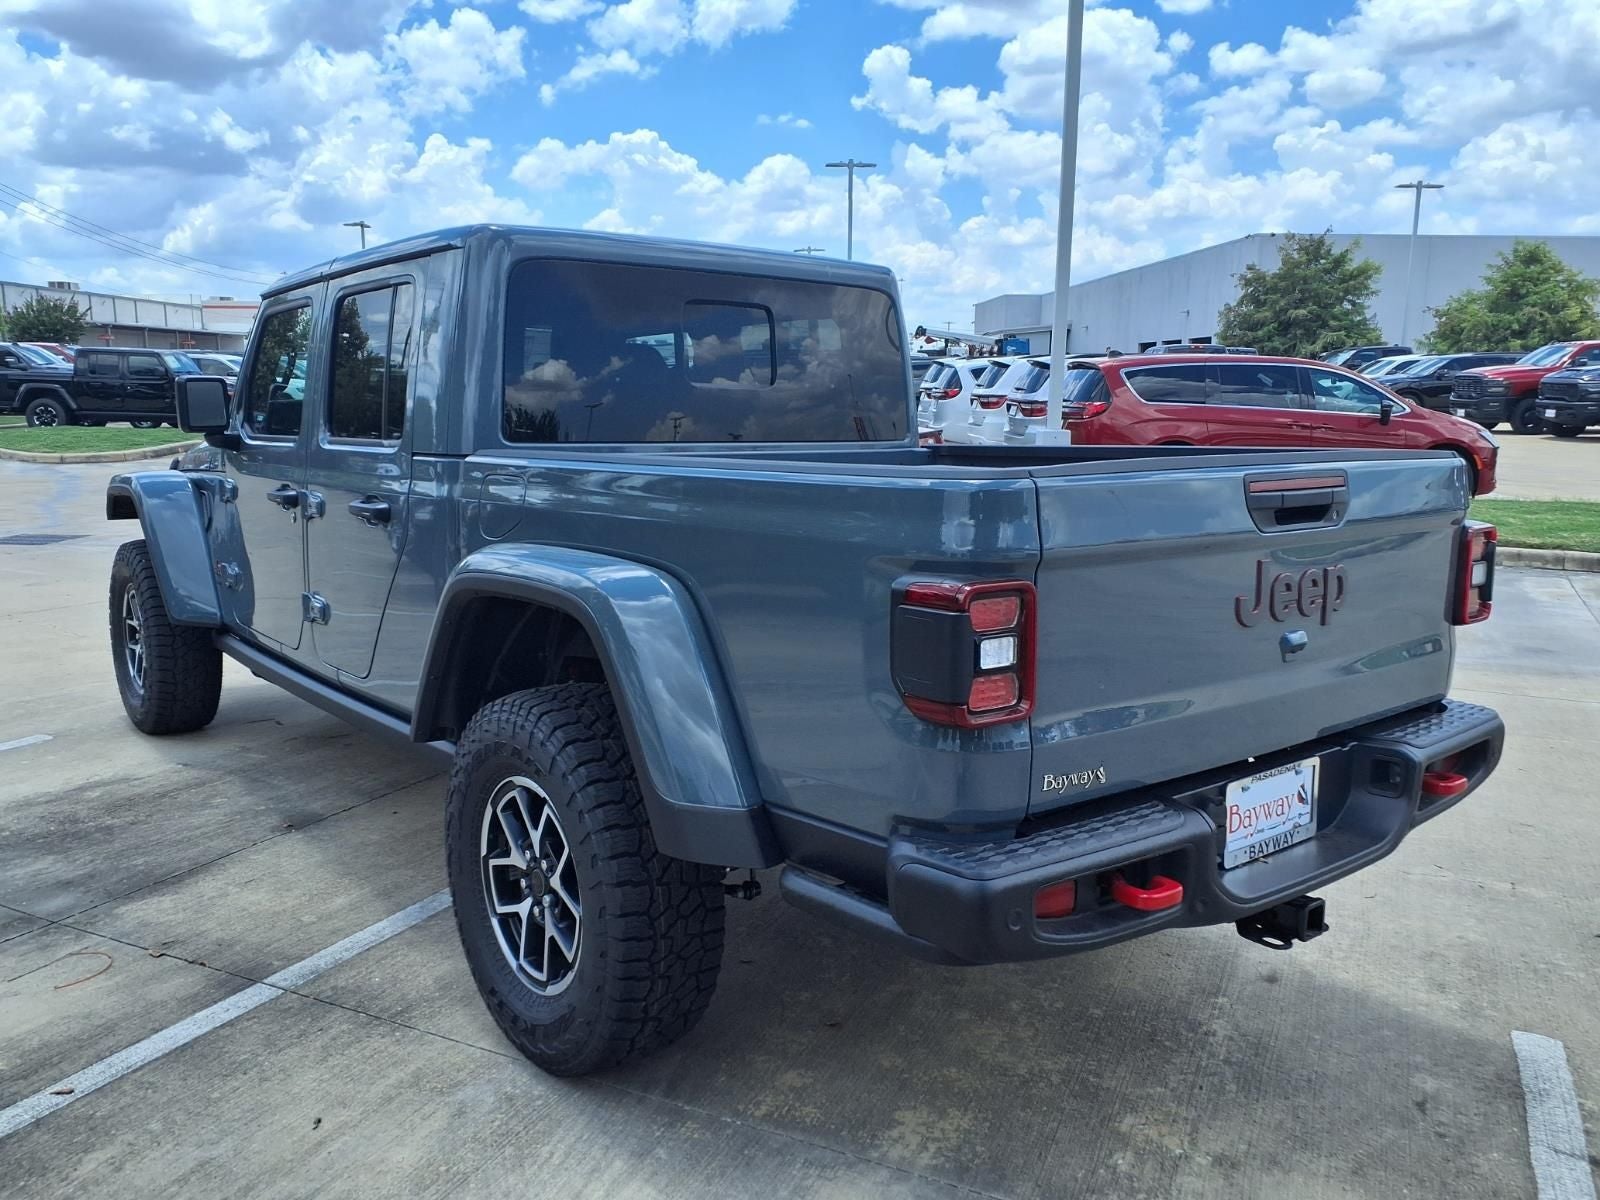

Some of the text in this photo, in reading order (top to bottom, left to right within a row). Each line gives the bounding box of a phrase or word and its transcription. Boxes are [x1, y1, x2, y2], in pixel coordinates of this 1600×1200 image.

[1234, 558, 1345, 628] Jeep
[1042, 769, 1097, 794] Bayway
[1250, 763, 1297, 784] PASADENA
[1228, 793, 1296, 838] Bayway
[1249, 830, 1297, 860] BAYWAY
